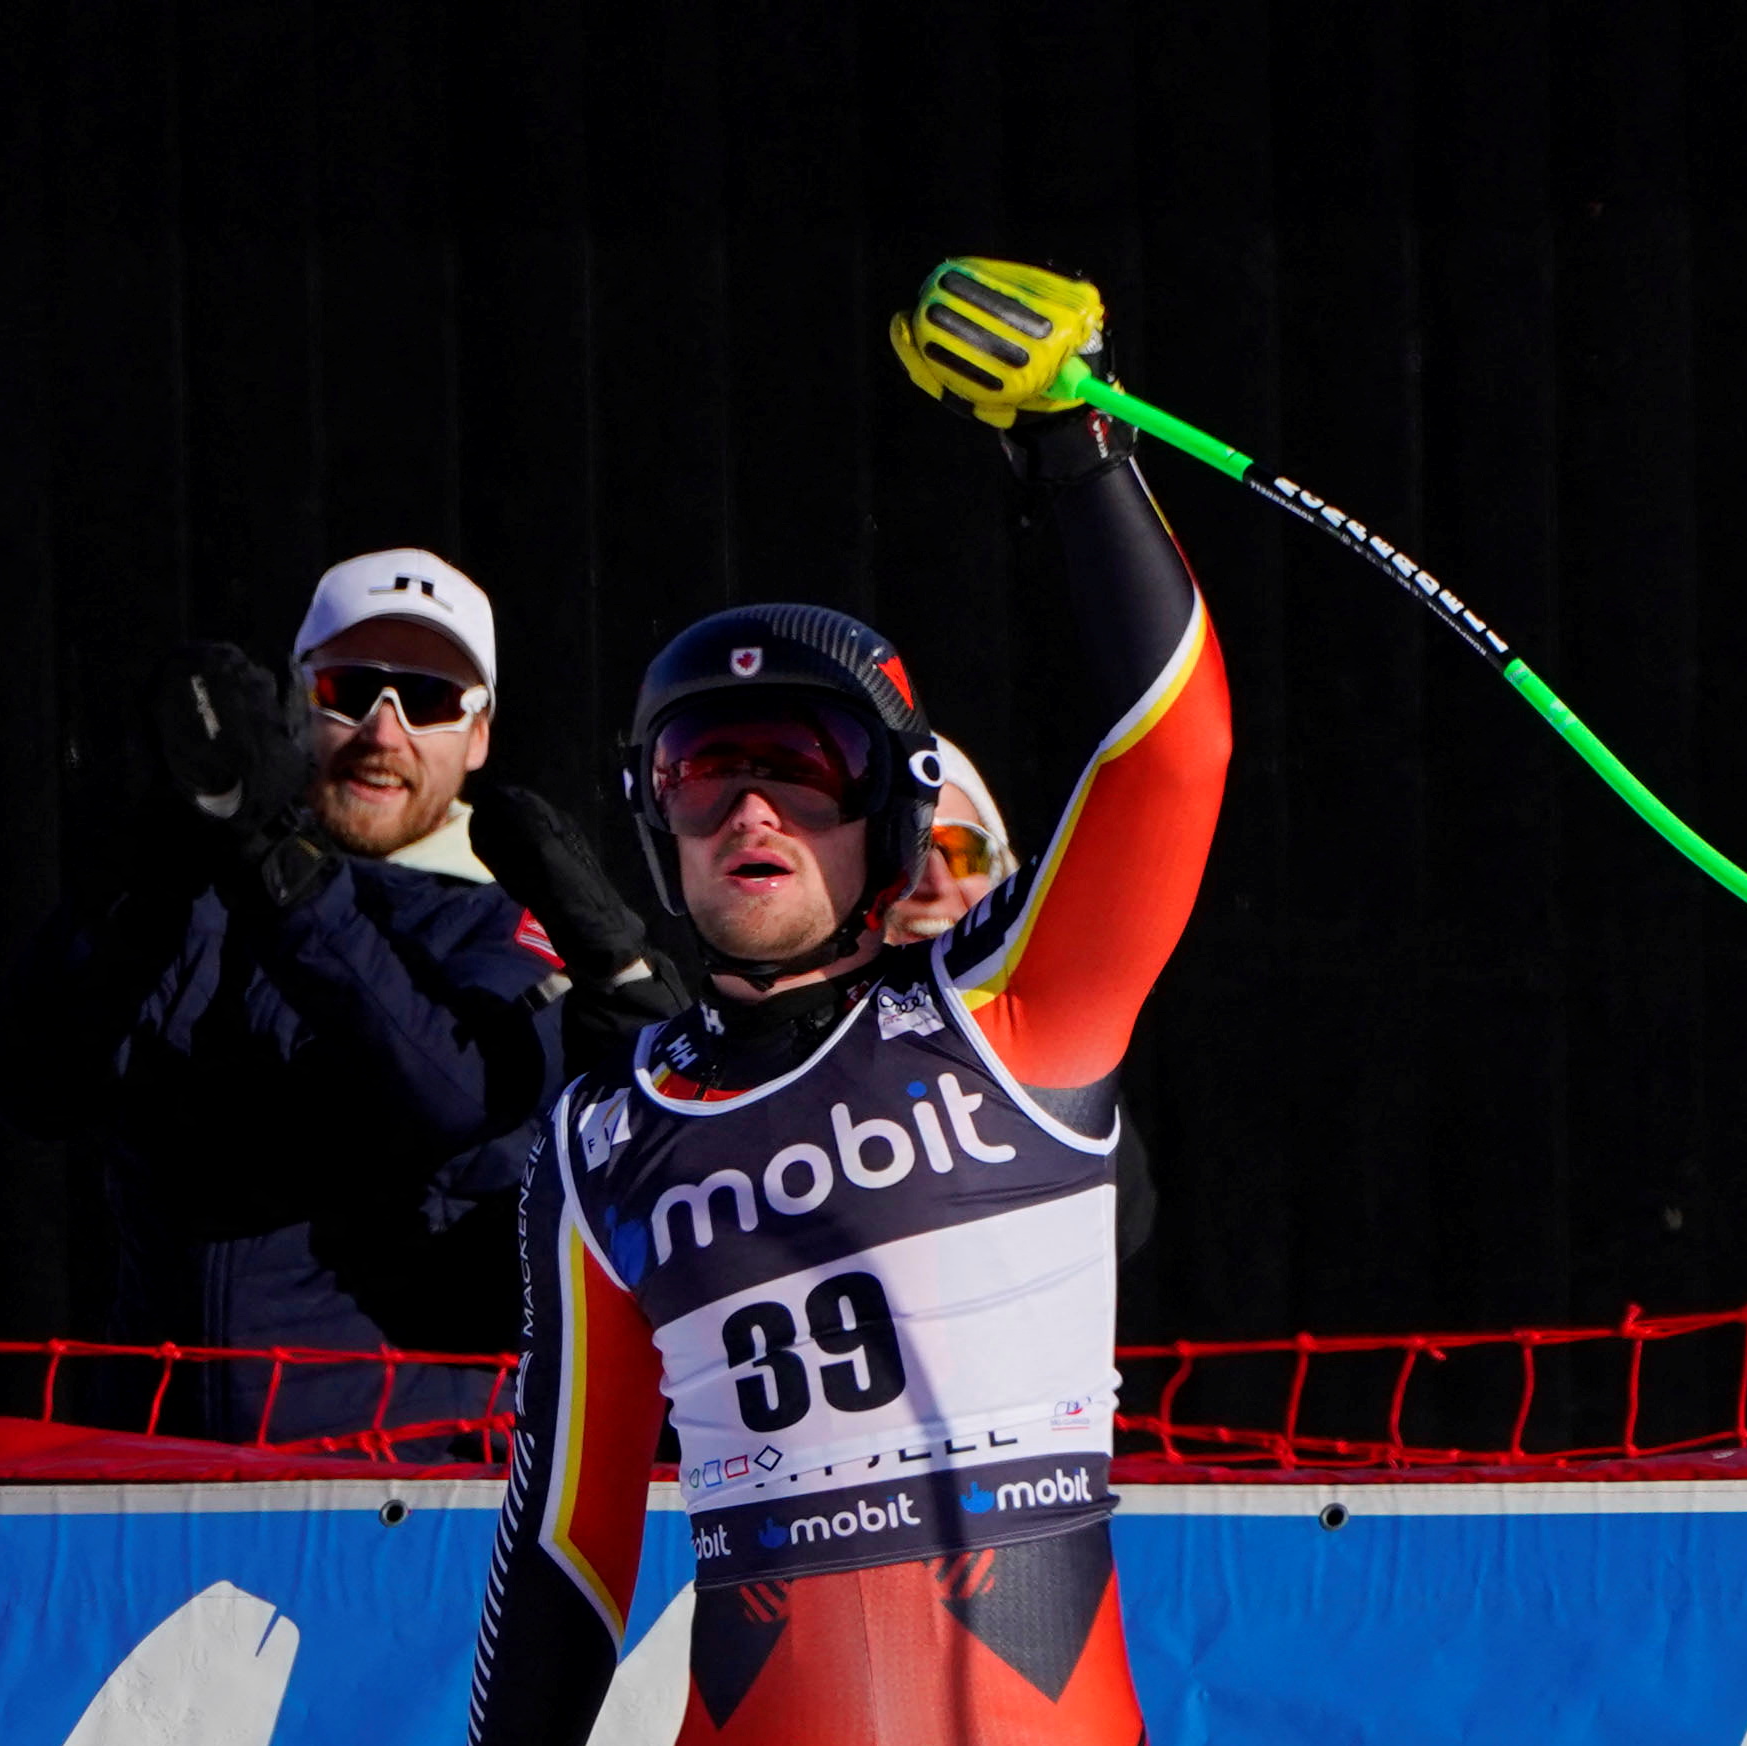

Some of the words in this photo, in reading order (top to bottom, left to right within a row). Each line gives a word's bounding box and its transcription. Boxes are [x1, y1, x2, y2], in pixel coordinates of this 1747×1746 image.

[654, 1073, 1016, 1267] mobit
[518, 1131, 547, 1338] MACKENZIE
[721, 1271, 907, 1434] 39
[691, 1524, 732, 1560] obit
[790, 1493, 921, 1545] mobit
[997, 1467, 1093, 1513] mobit
